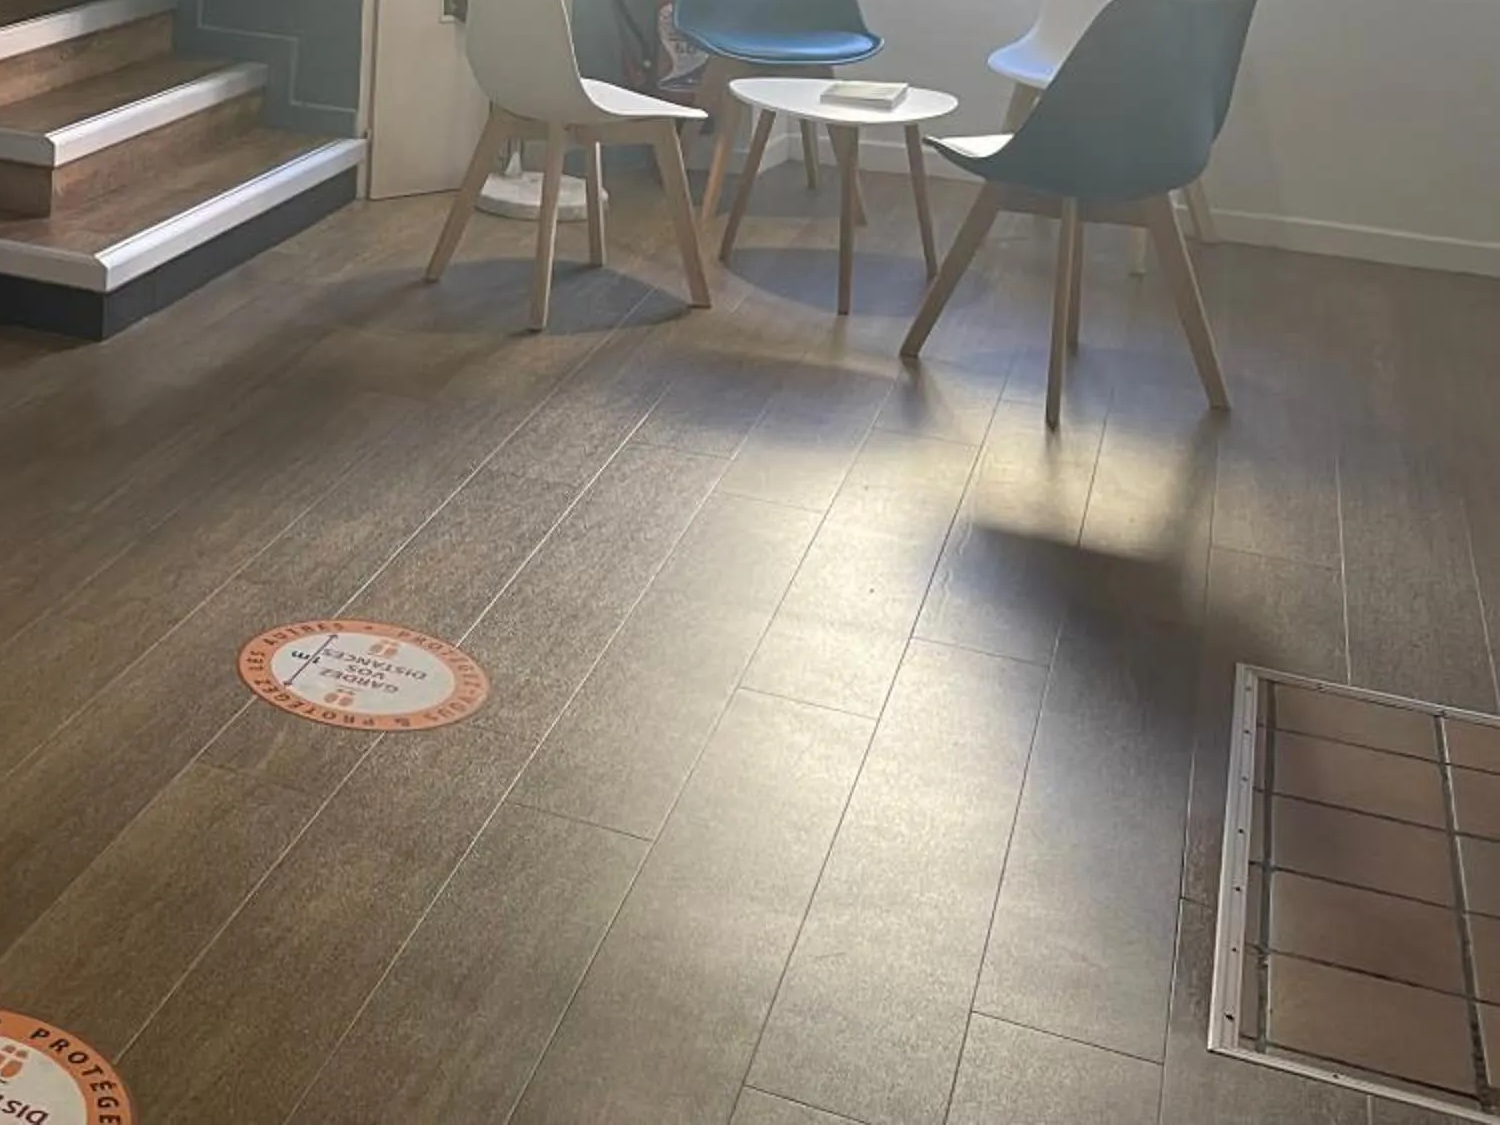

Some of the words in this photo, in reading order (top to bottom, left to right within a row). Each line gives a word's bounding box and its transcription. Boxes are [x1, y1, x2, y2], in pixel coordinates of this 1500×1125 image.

[323, 648, 427, 681] DISTANCES
[347, 664, 385, 680] VOS
[320, 668, 399, 694] GARDEZ
[29, 1027, 121, 1125] PROTÉGE
